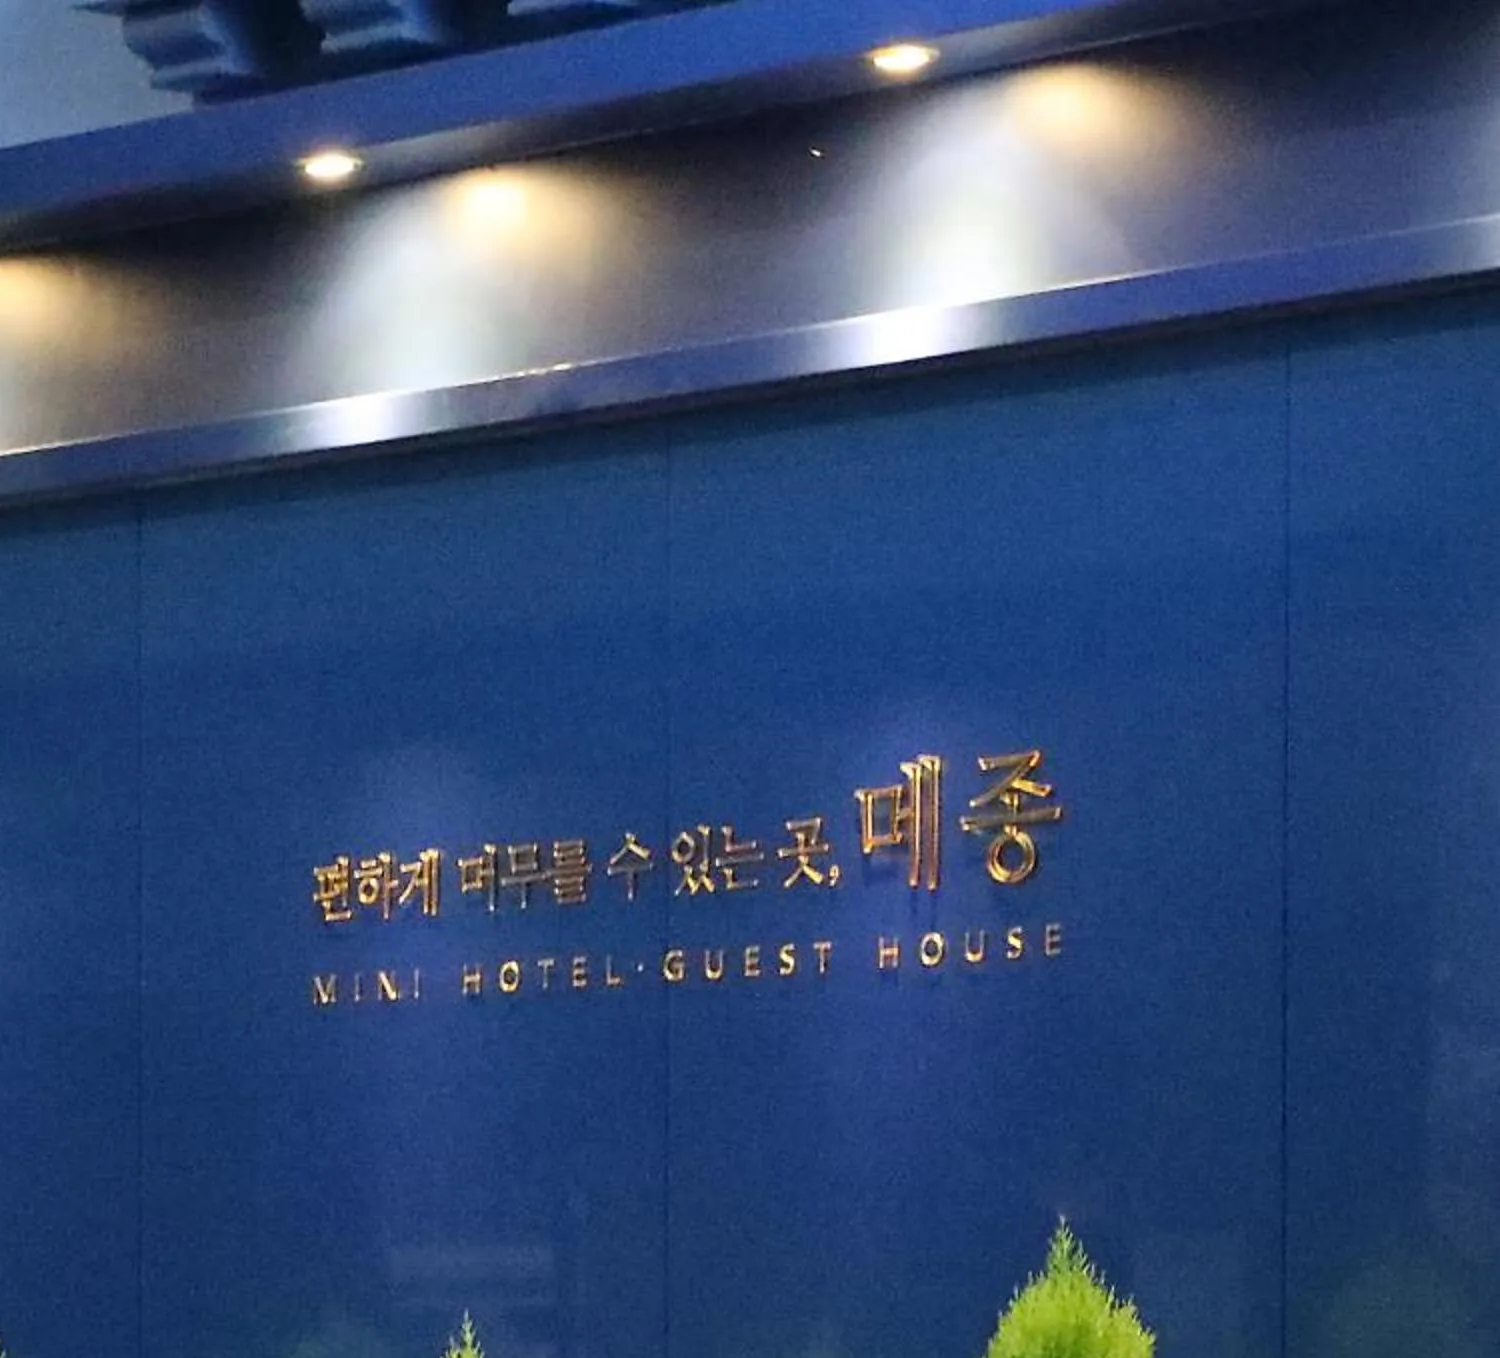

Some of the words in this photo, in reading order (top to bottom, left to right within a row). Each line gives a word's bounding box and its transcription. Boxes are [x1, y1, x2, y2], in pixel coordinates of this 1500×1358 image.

[312, 847, 441, 922] 편하게
[457, 838, 594, 912] 머무를
[606, 831, 654, 900] 수
[670, 823, 766, 896] 있는
[776, 815, 841, 889] 곳,
[853, 750, 1064, 892] 메종
[312, 968, 421, 1004] MINI
[878, 922, 1063, 970] HOUSE
